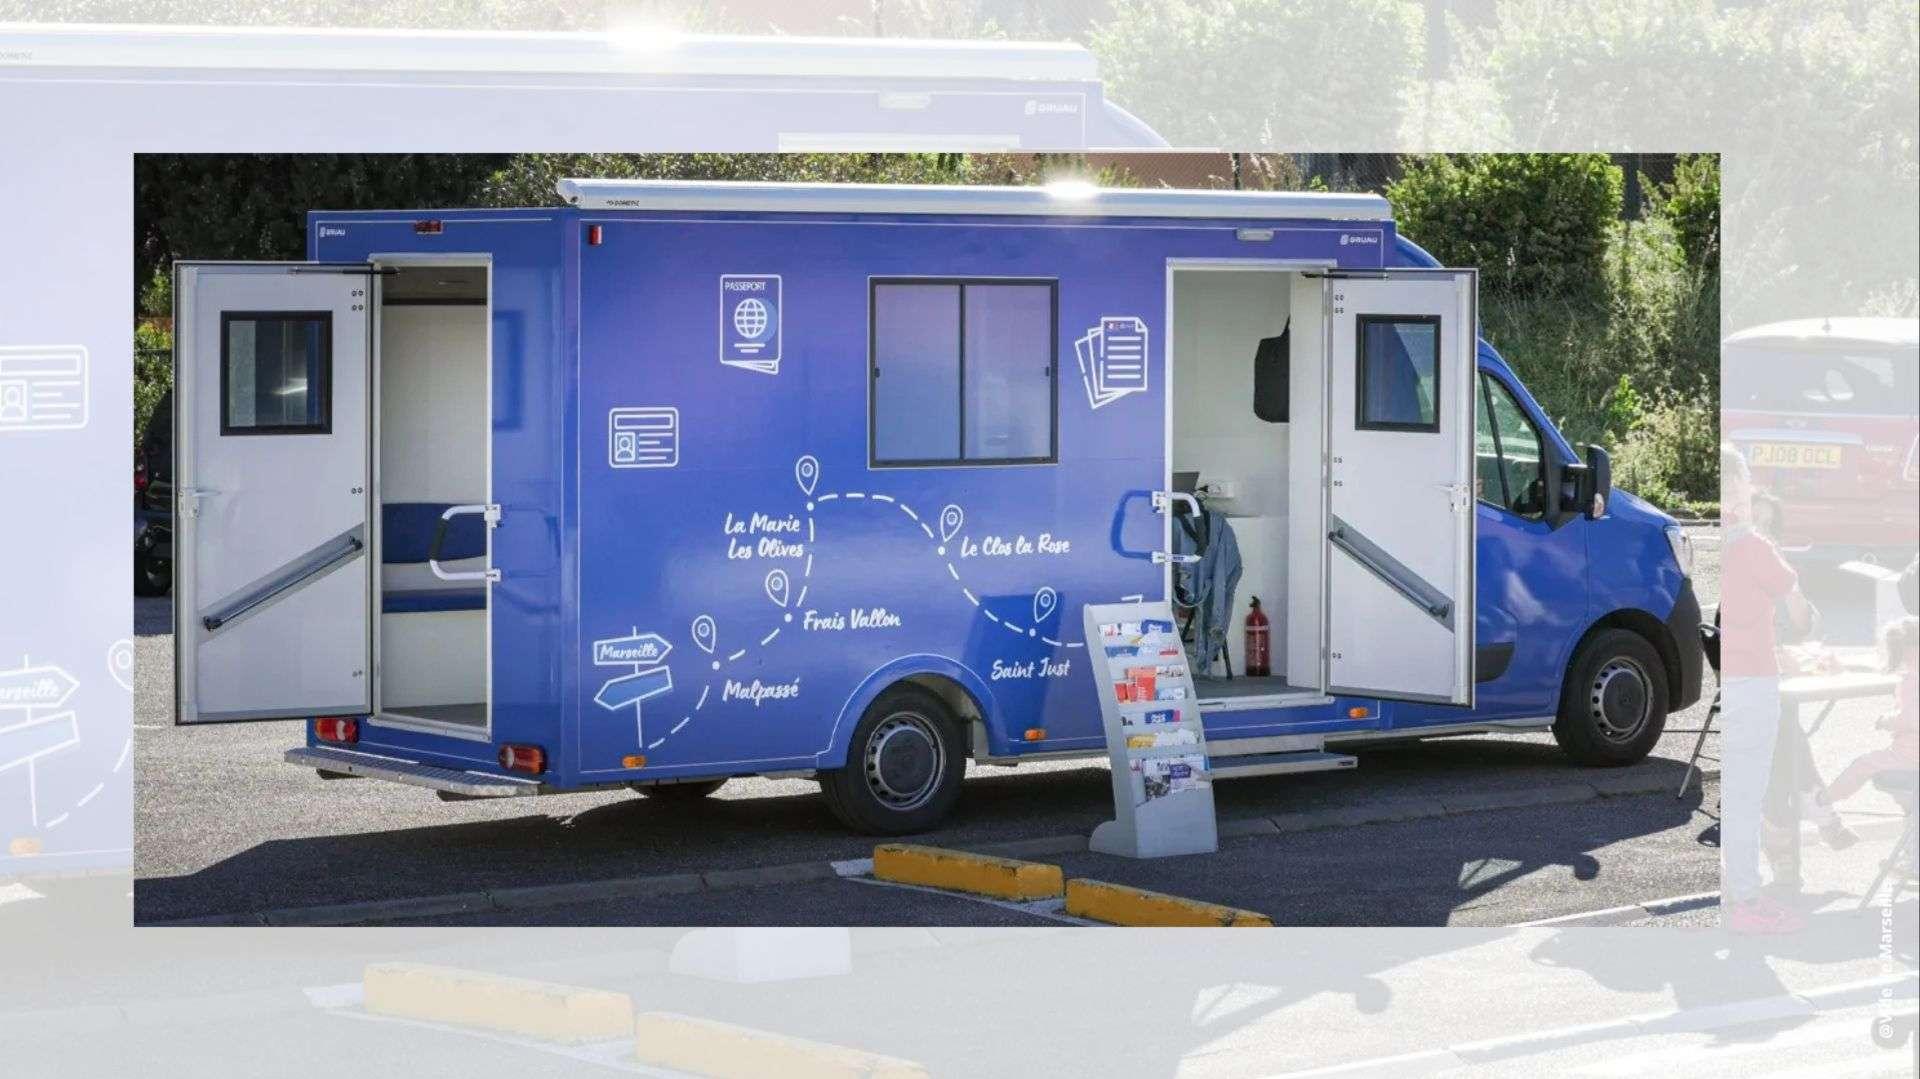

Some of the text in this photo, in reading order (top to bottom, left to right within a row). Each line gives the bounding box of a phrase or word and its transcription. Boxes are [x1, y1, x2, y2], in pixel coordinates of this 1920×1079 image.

[724, 281, 766, 291] PASSEPORT
[724, 511, 800, 534] La Marie
[728, 536, 803, 559] Les Olives
[961, 533, 1071, 558] Le Clos la Rose
[803, 608, 902, 631] Frais Vallon
[600, 643, 658, 660] Marseille
[991, 657, 1070, 680] Saint Just
[722, 677, 800, 706] Malpassé
